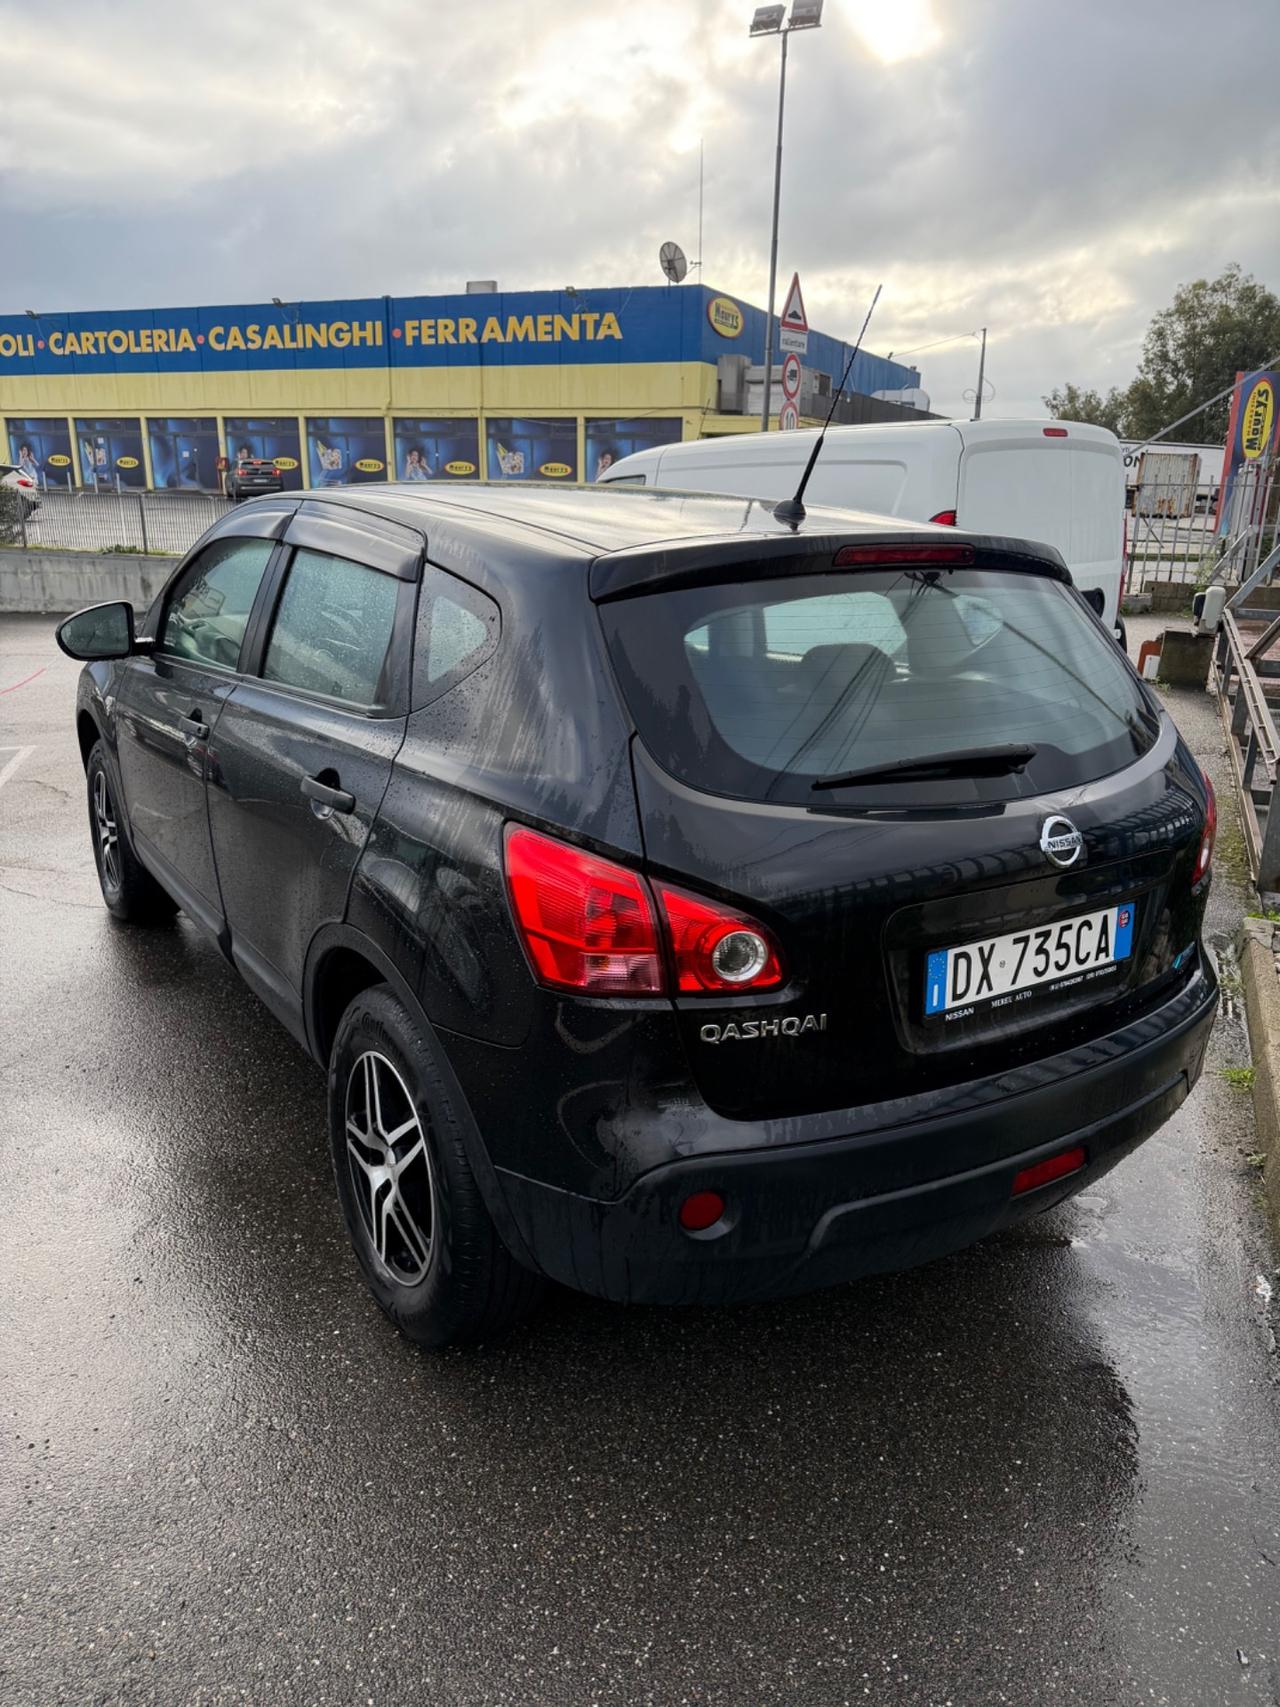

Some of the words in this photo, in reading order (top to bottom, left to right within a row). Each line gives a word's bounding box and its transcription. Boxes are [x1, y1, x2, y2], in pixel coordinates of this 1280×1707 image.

[49, 327, 197, 356] CARTOLERIA
[208, 320, 383, 351] CASALINGHI
[404, 312, 623, 346] FERRAMENTA
[1047, 834, 1081, 849] NISSAN
[951, 943, 995, 1002] DX
[1010, 914, 1110, 987] 735CA
[700, 1012, 828, 1045] QASHQAI
[945, 1006, 975, 1022] NISSAN
